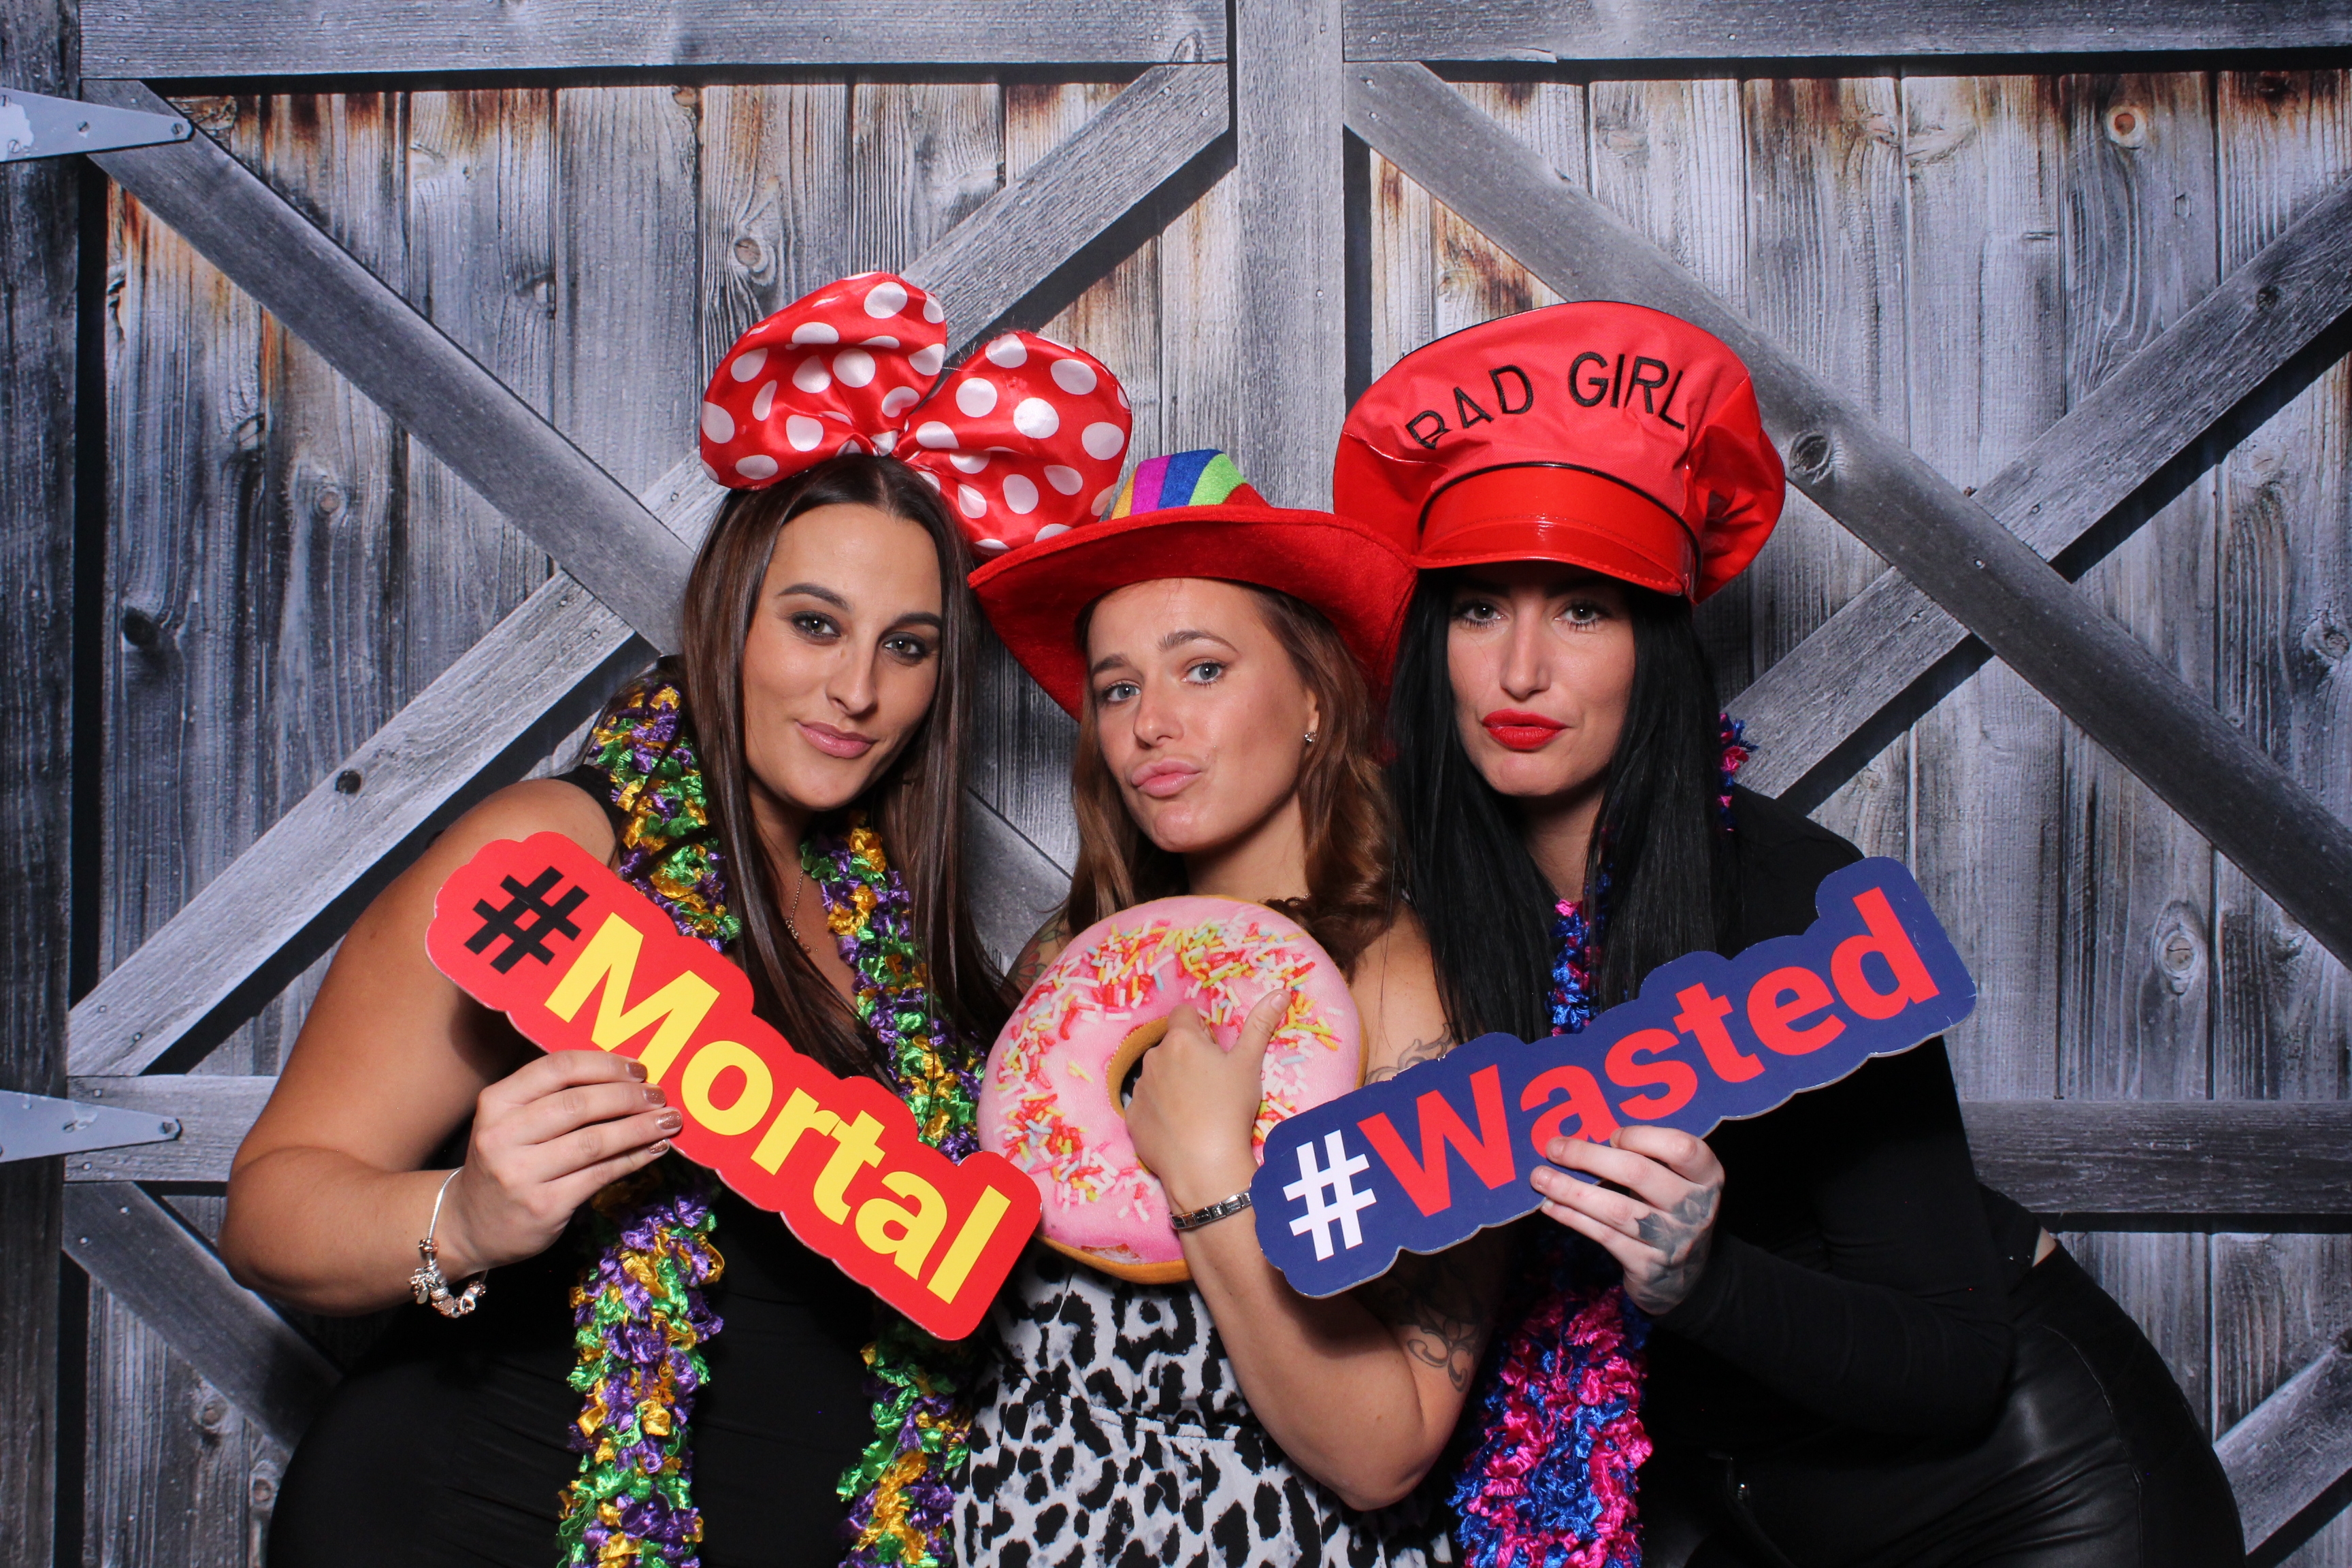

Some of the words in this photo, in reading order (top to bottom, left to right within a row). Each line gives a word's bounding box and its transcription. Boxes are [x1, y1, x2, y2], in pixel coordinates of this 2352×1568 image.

[1405, 365, 1535, 451] BAD
[1569, 351, 1686, 431] GIRL
[465, 866, 1011, 1305] #Mortal
[1283, 886, 1939, 1262] #Wasted
